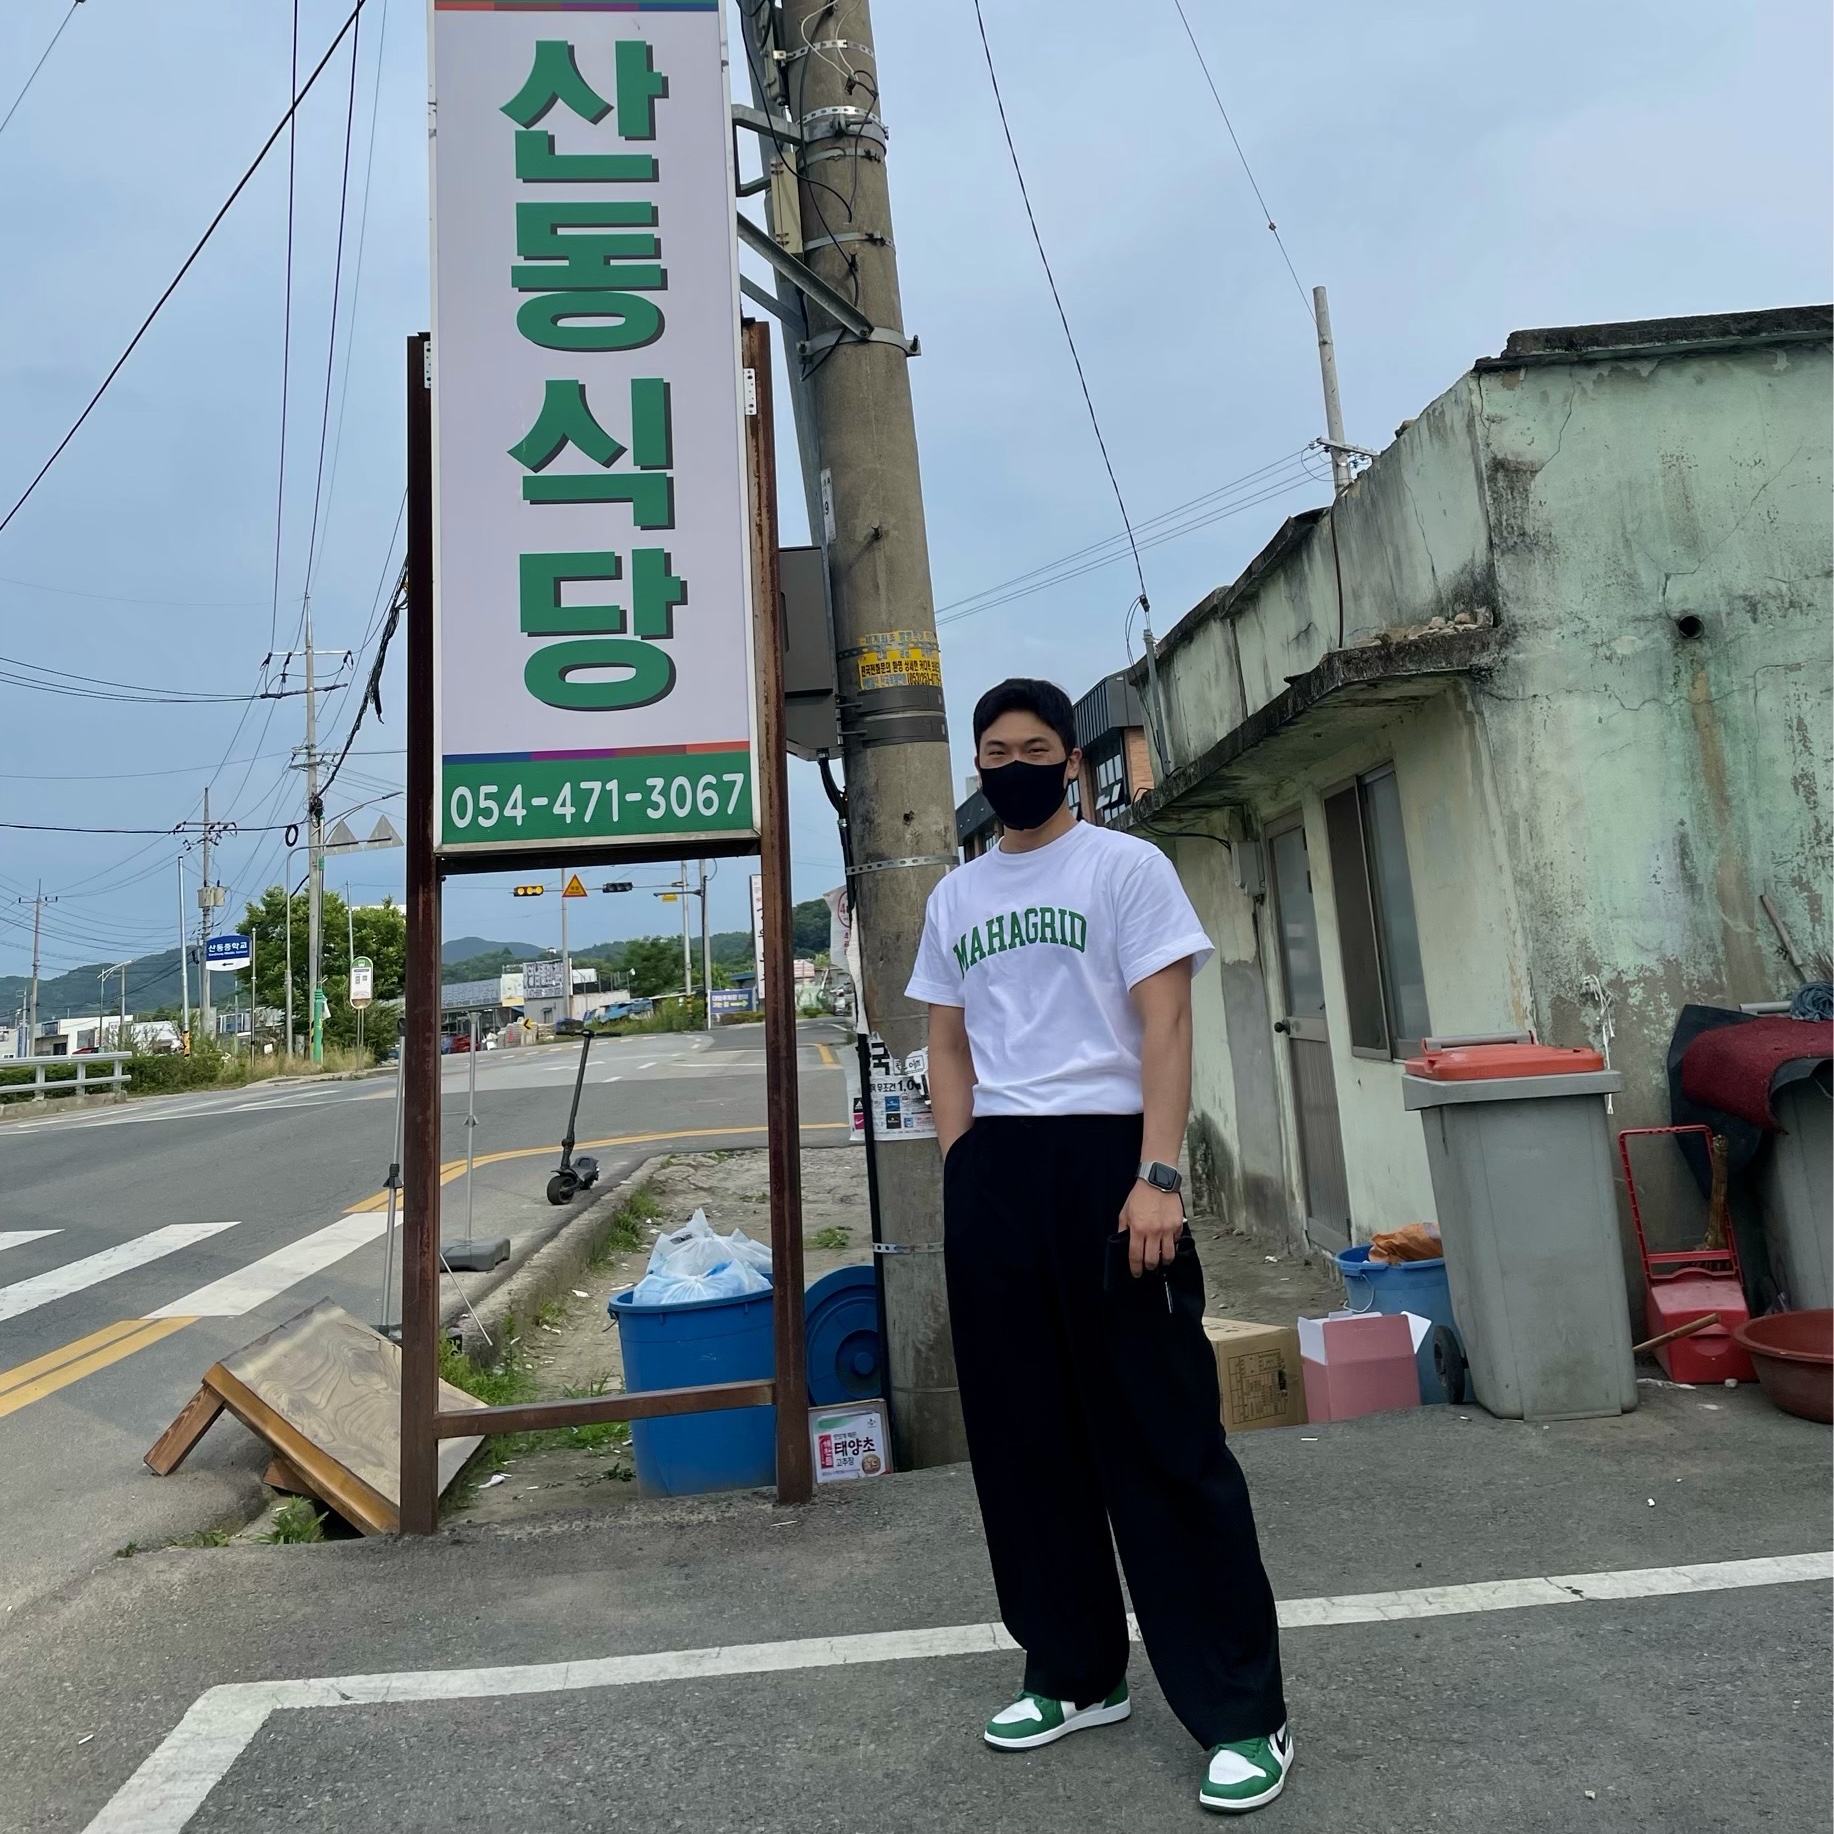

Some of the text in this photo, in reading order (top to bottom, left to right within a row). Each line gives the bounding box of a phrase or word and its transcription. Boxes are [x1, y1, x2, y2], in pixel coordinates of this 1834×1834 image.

[498, 39, 688, 712] 산동식당
[450, 772, 744, 828] 054-471-3067
[208, 941, 248, 953] 산동중학교
[953, 906, 1087, 981] MAHAGRID
[834, 1436, 876, 1457] 태양초
[836, 1457, 854, 1467] 고추장
